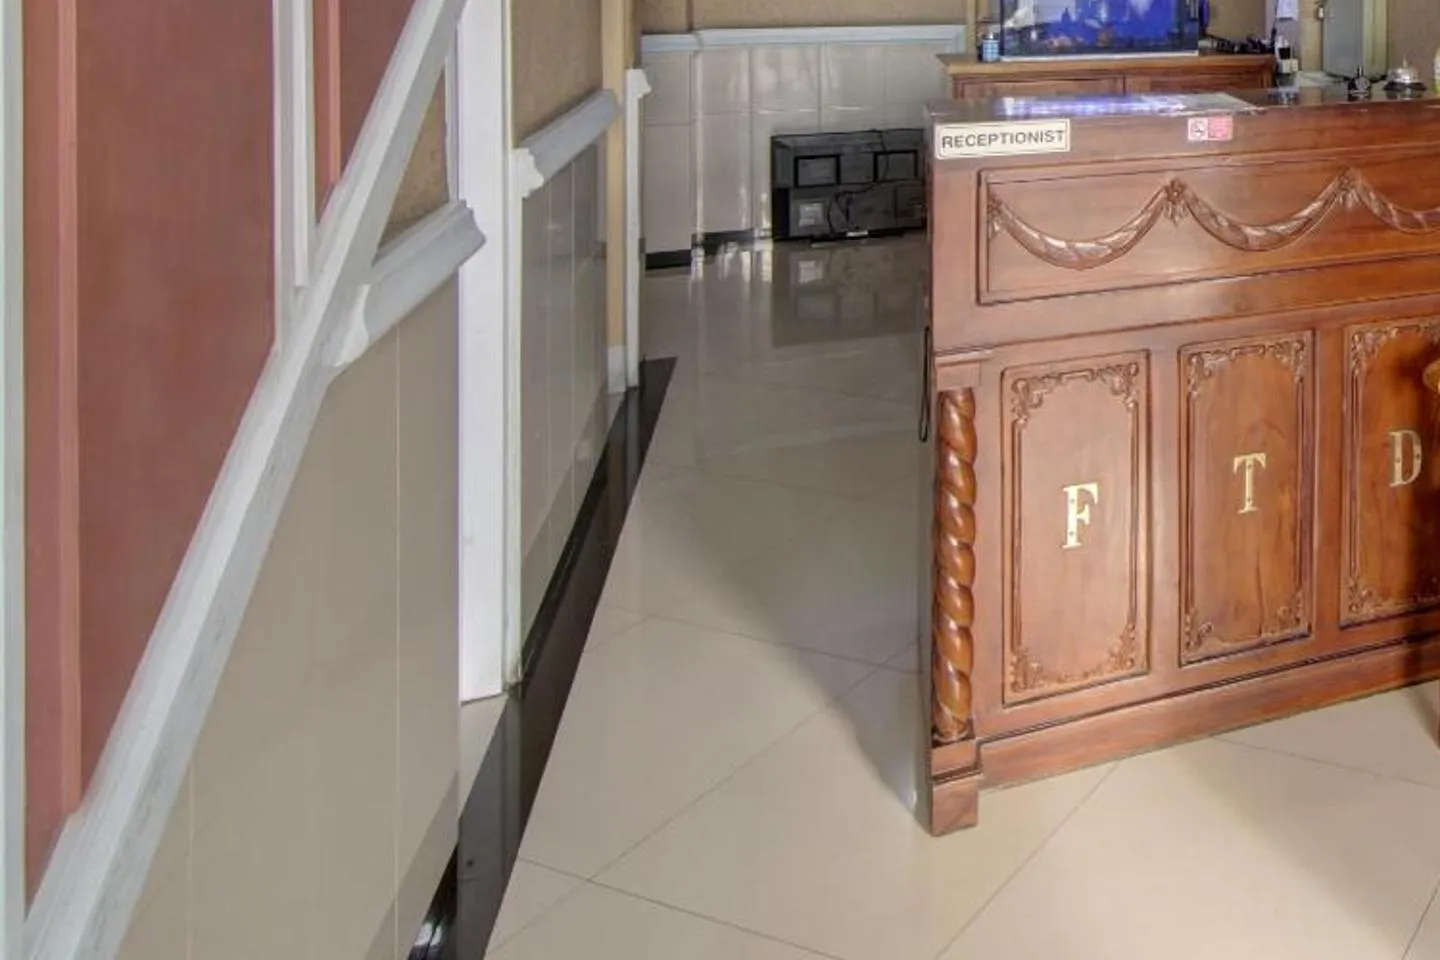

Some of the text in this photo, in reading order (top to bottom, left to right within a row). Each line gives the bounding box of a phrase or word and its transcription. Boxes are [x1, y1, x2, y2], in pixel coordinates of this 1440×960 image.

[941, 130, 1065, 149] RECEPTIONIST
[1062, 430, 1422, 549] F T D
